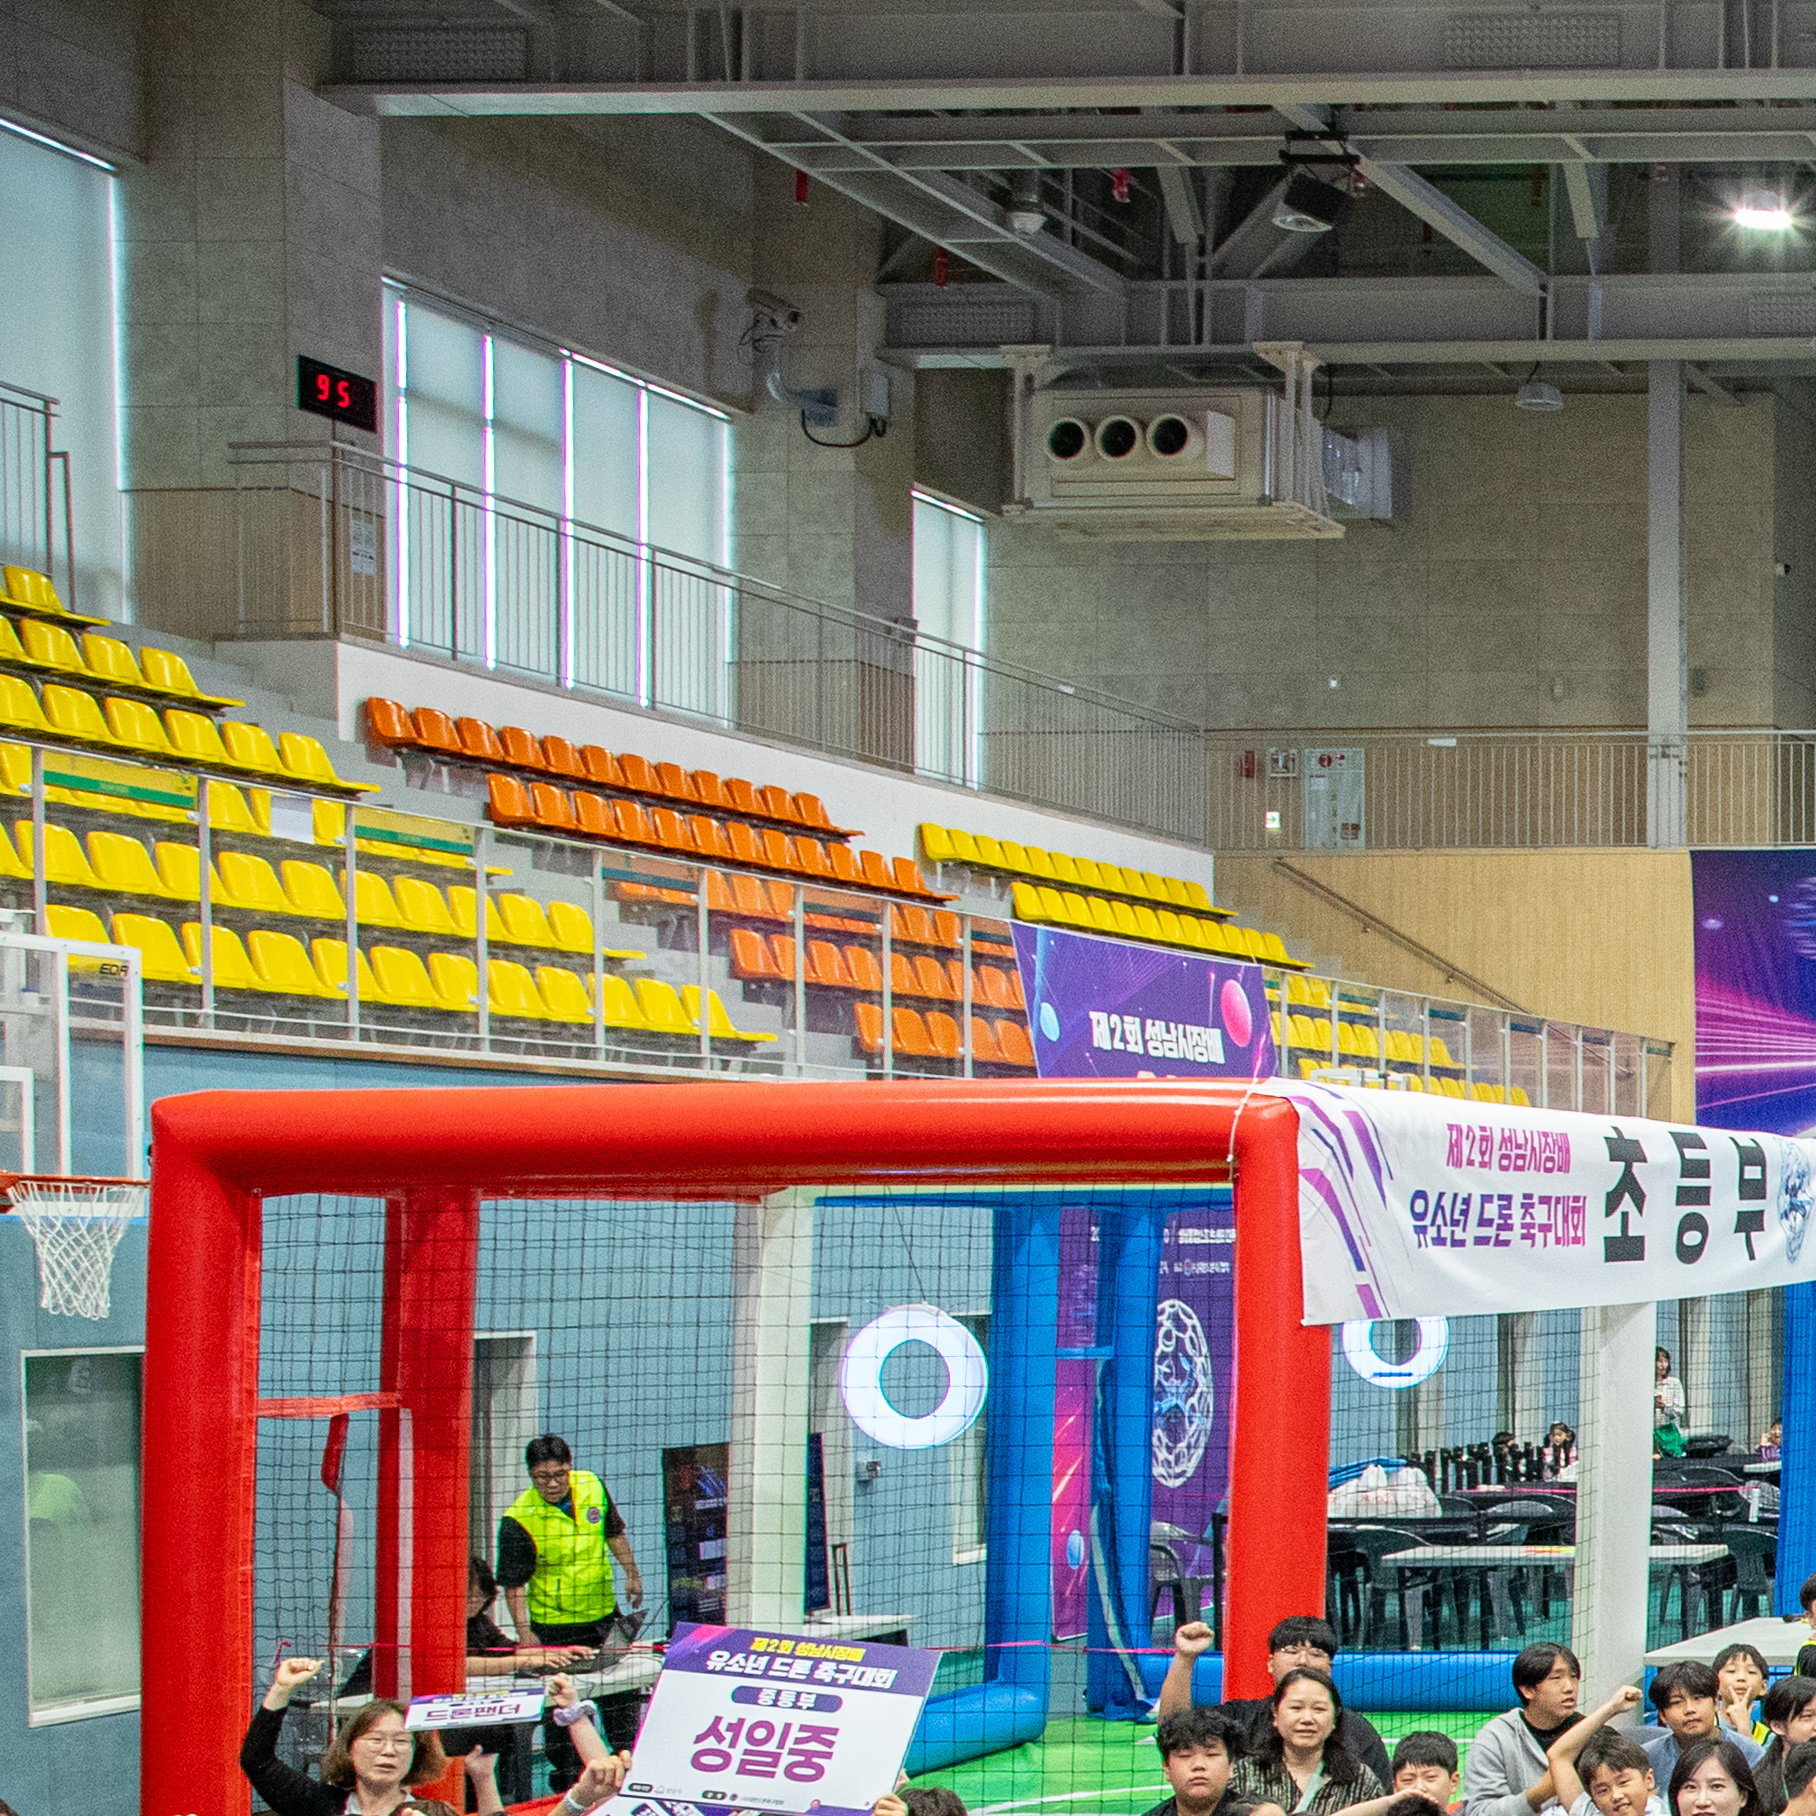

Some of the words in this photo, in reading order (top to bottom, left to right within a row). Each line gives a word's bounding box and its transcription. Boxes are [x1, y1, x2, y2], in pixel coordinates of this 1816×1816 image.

[1089, 1011, 1144, 1054] 제2회
[1144, 1018, 1225, 1064] 성남시장배
[1446, 1123, 1494, 1170] 제2회
[1498, 1127, 1571, 1173] 성남시장배
[1410, 1189, 1472, 1249] 유소년
[1473, 1193, 1514, 1247] 드론
[1519, 1193, 1587, 1248] 축구대회
[1603, 1125, 1767, 1265] 초등부
[705, 1651, 767, 1676] 유소년
[771, 1657, 811, 1681] 드론
[813, 1662, 898, 1689] 축구대회
[690, 1714, 841, 1783] 성일중
